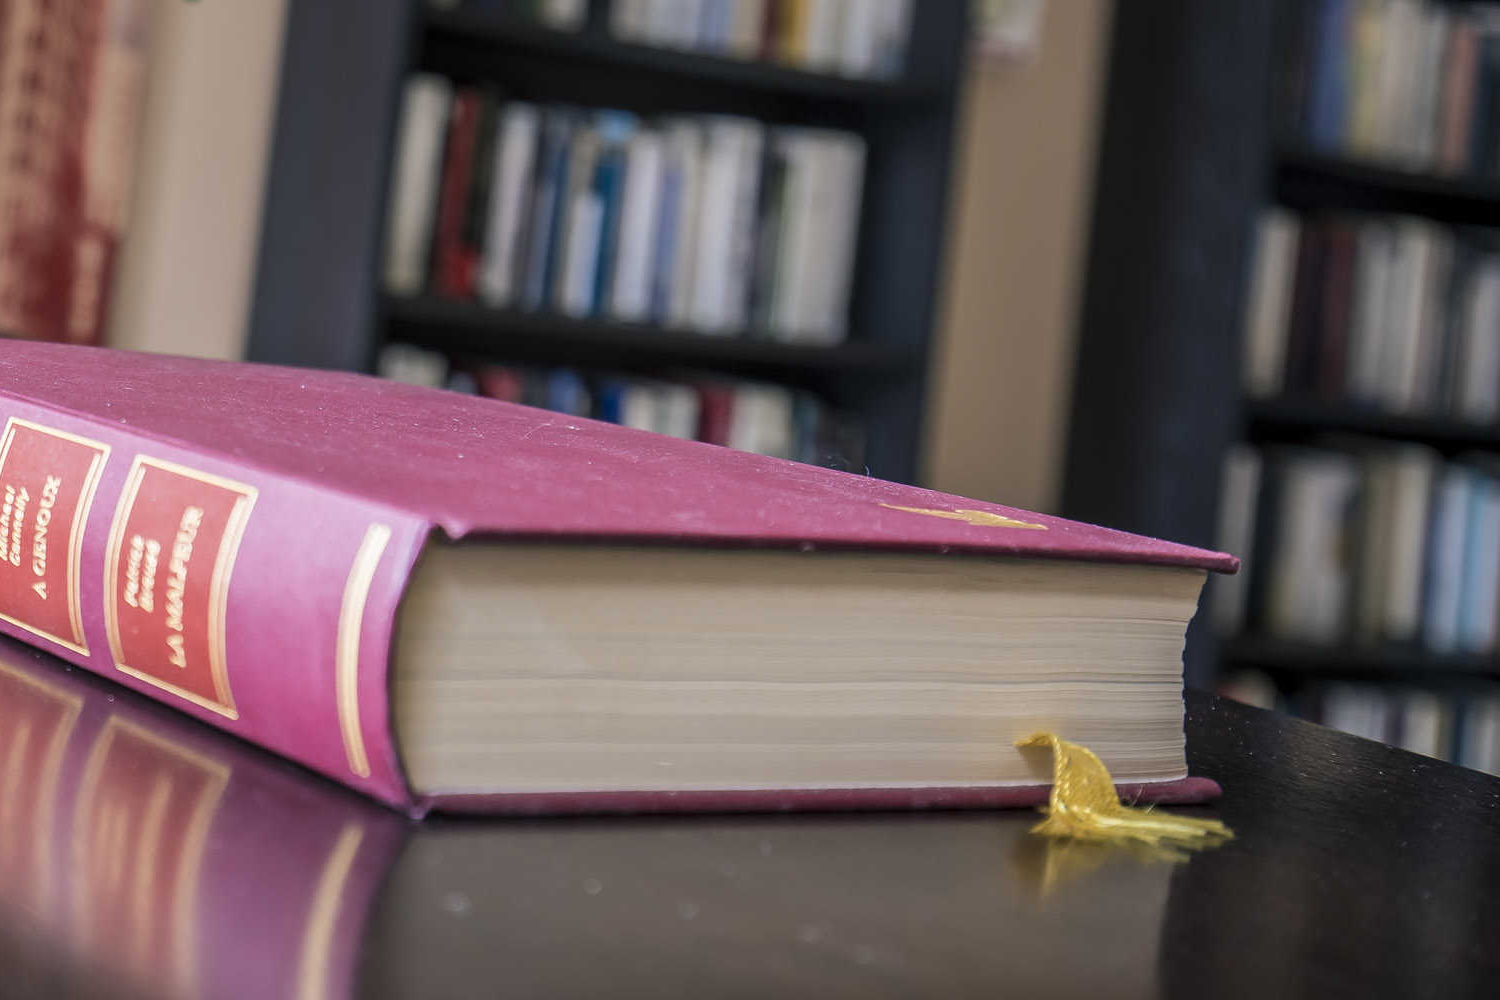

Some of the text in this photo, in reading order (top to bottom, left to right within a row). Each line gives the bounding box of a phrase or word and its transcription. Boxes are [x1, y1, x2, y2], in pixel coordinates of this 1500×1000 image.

[9, 486, 30, 567] Connelly
[31, 474, 62, 600] A GENOUX
